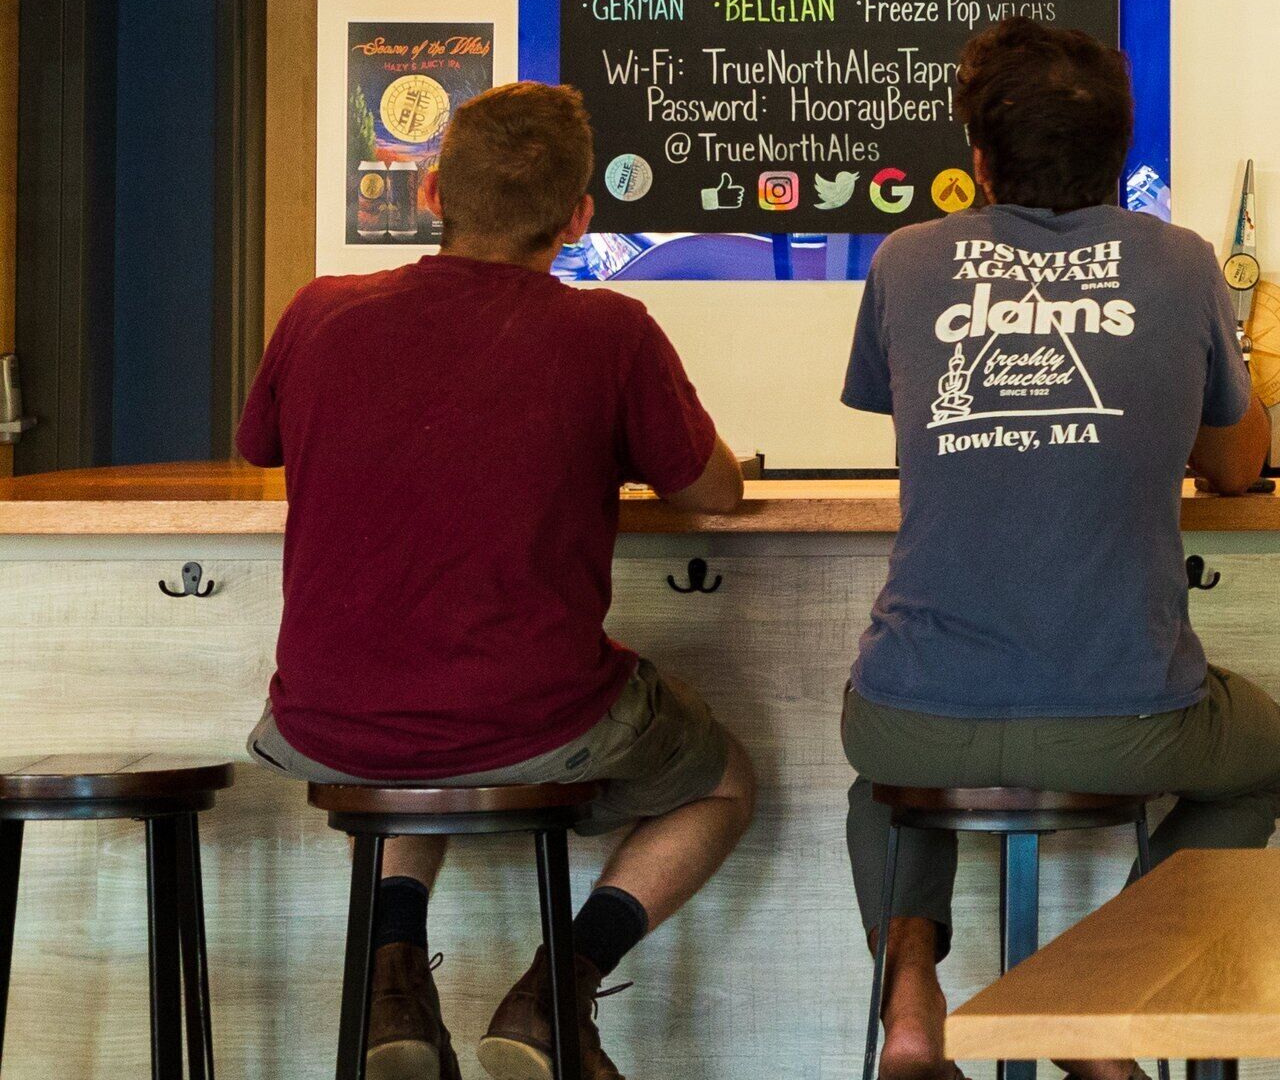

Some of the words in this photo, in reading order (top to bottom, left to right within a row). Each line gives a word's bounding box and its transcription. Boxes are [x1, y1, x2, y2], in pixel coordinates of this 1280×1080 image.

[602, 49, 683, 84] Wi-Fi:
[648, 87, 767, 122] Password:
[791, 86, 953, 129] HoorayBeer!
[953, 240, 1122, 268] IPSWICH
[952, 261, 1119, 283] AGAWAM
[1081, 281, 1120, 290] BRAND
[935, 283, 1136, 342] clams
[985, 346, 1065, 375] freshly
[983, 366, 1075, 389] shucked
[1000, 388, 1027, 397] SINCE
[1029, 388, 1049, 396] 1922
[937, 426, 1040, 455] Rowley,
[1048, 423, 1100, 445] MA
